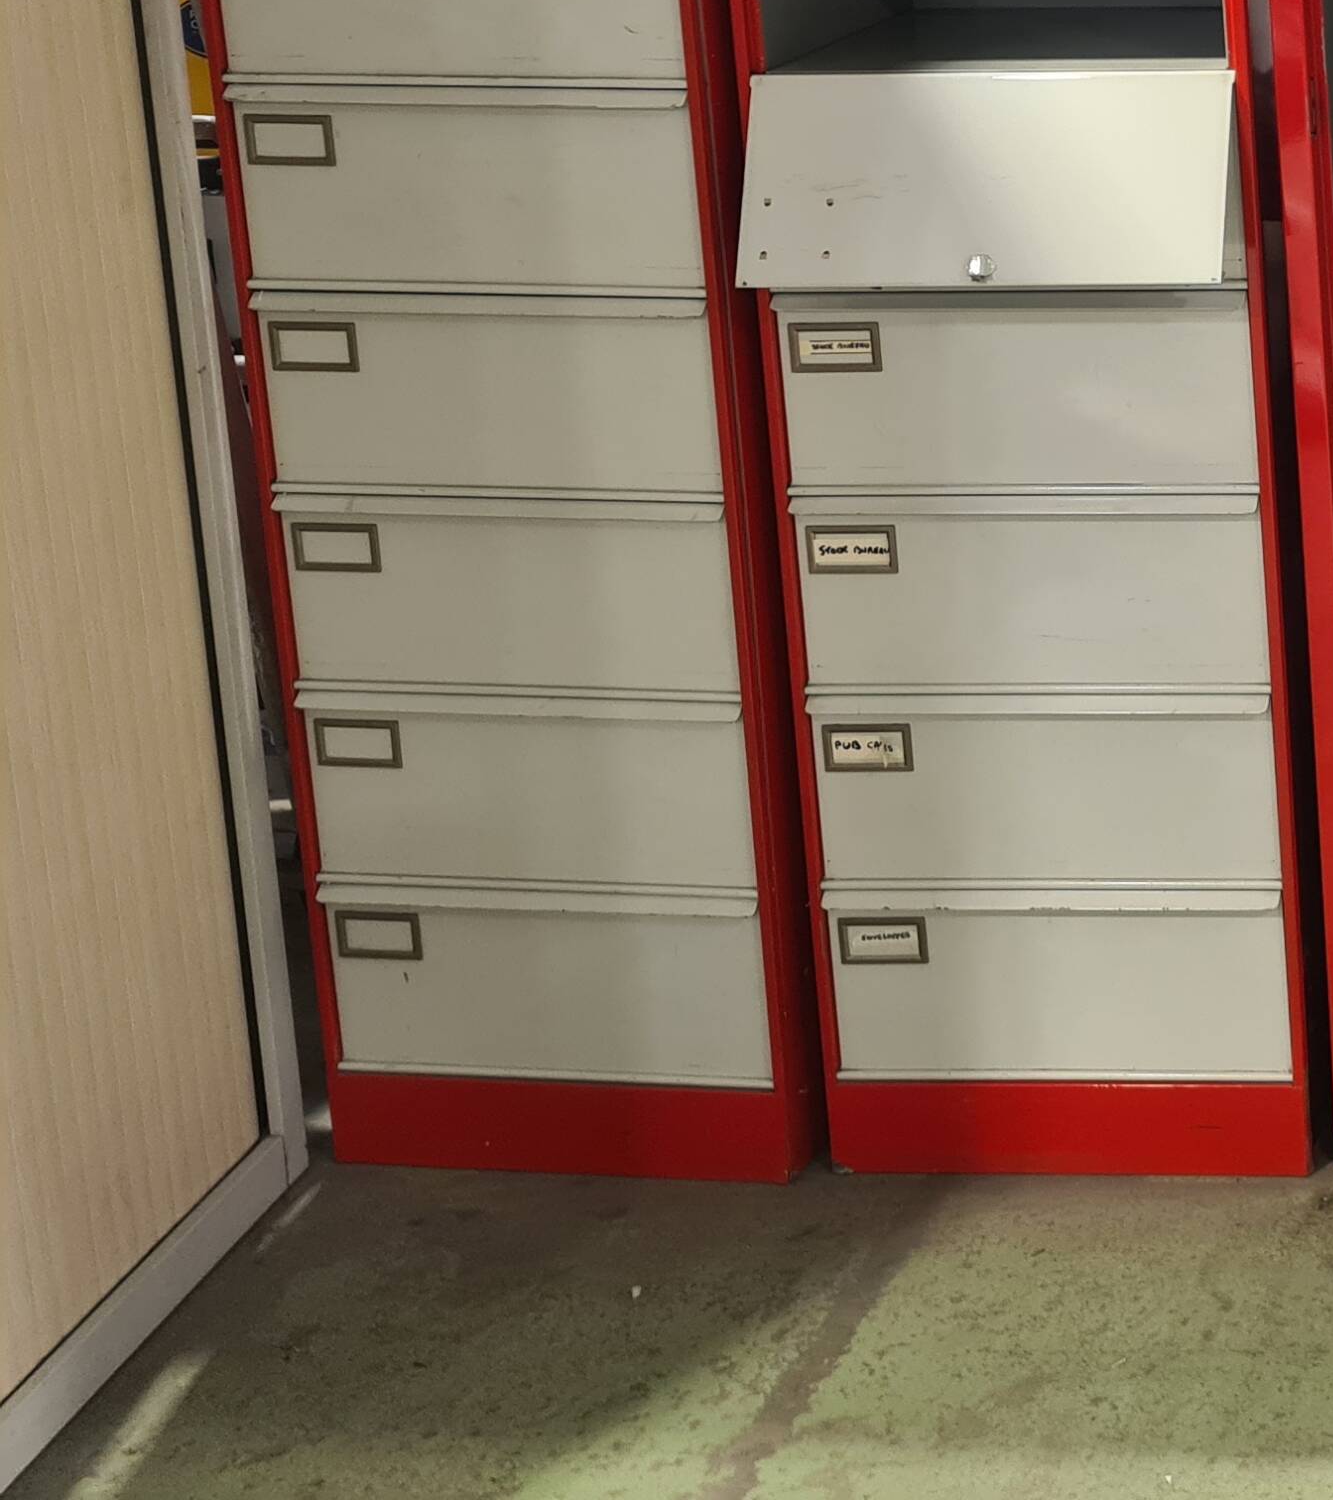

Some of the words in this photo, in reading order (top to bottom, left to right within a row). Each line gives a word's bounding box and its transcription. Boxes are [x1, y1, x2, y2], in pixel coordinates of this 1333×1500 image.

[818, 544, 849, 557] STOCK
[853, 545, 891, 555] BUREAU
[833, 739, 862, 751] PUB
